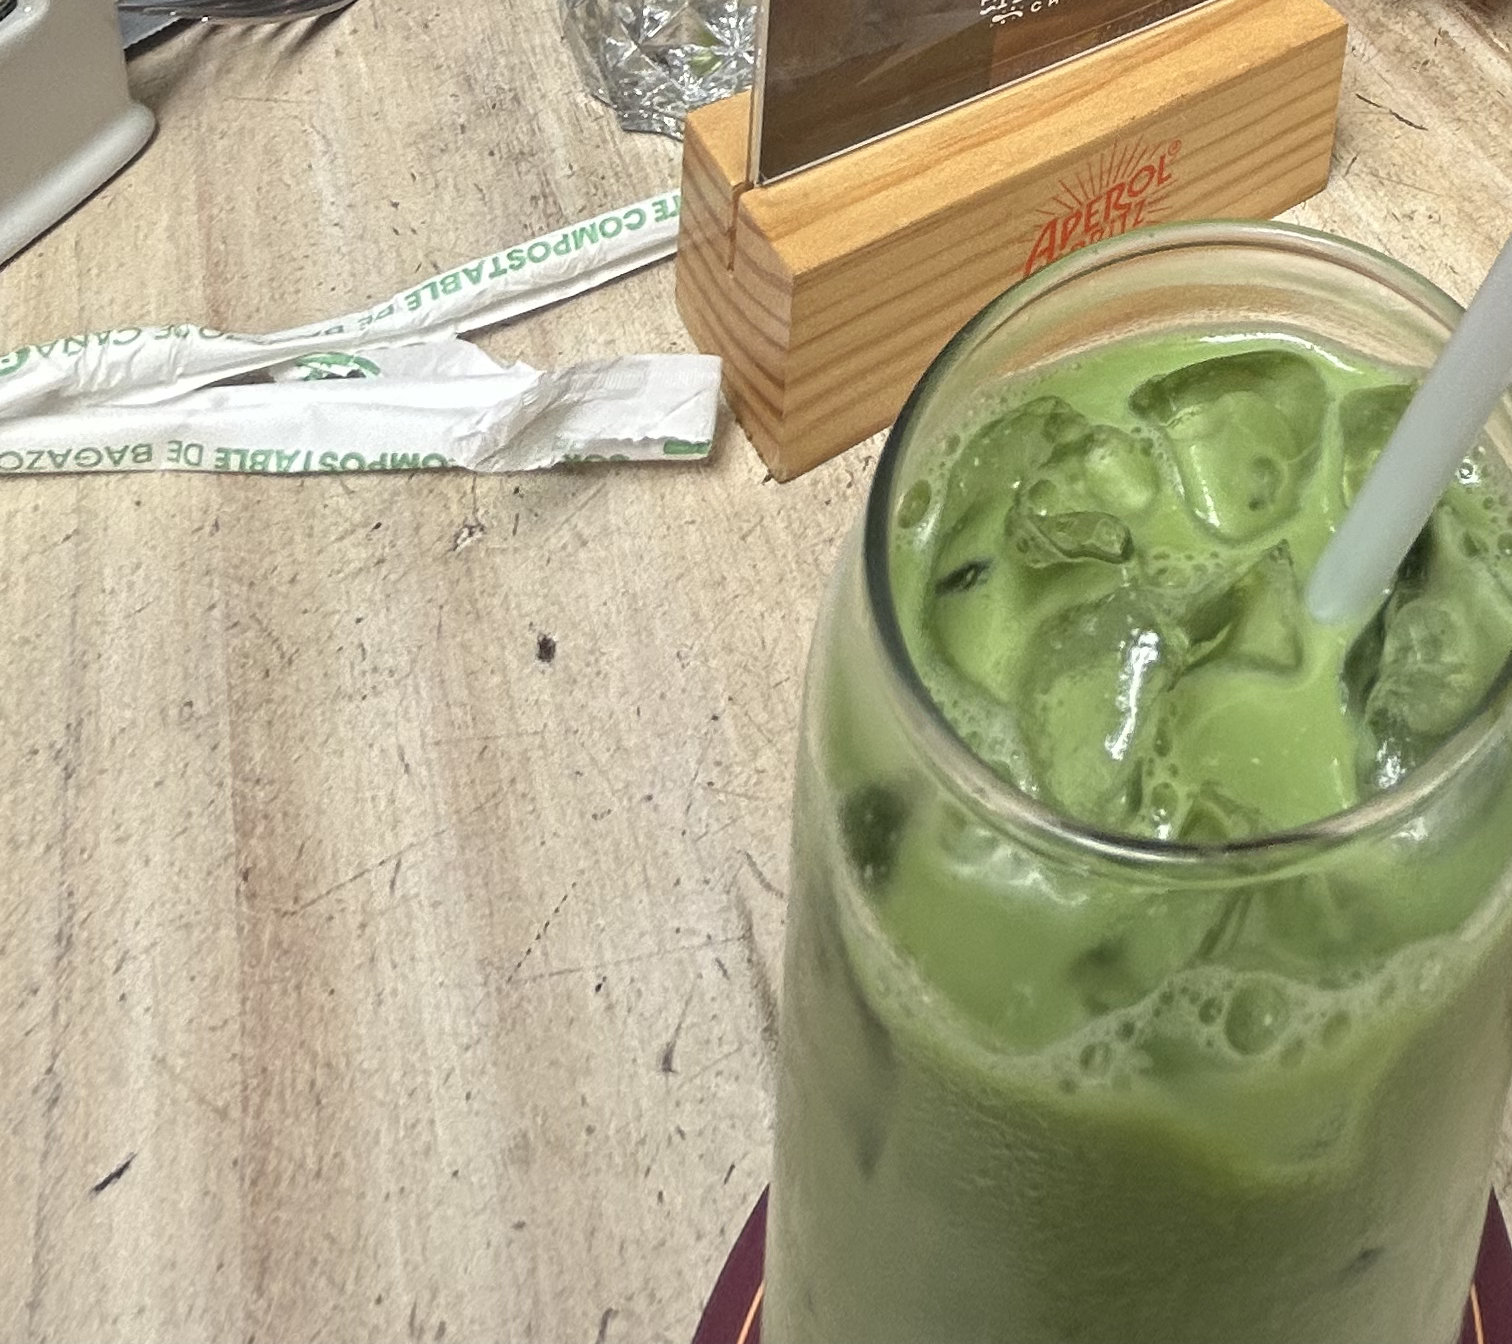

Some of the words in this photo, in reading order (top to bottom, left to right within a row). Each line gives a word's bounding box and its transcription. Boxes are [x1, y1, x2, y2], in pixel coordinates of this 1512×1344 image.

[404, 207, 647, 312] COMPOSTABLE
[167, 439, 204, 467] DE
[214, 445, 458, 472] OMPOSTABLE
